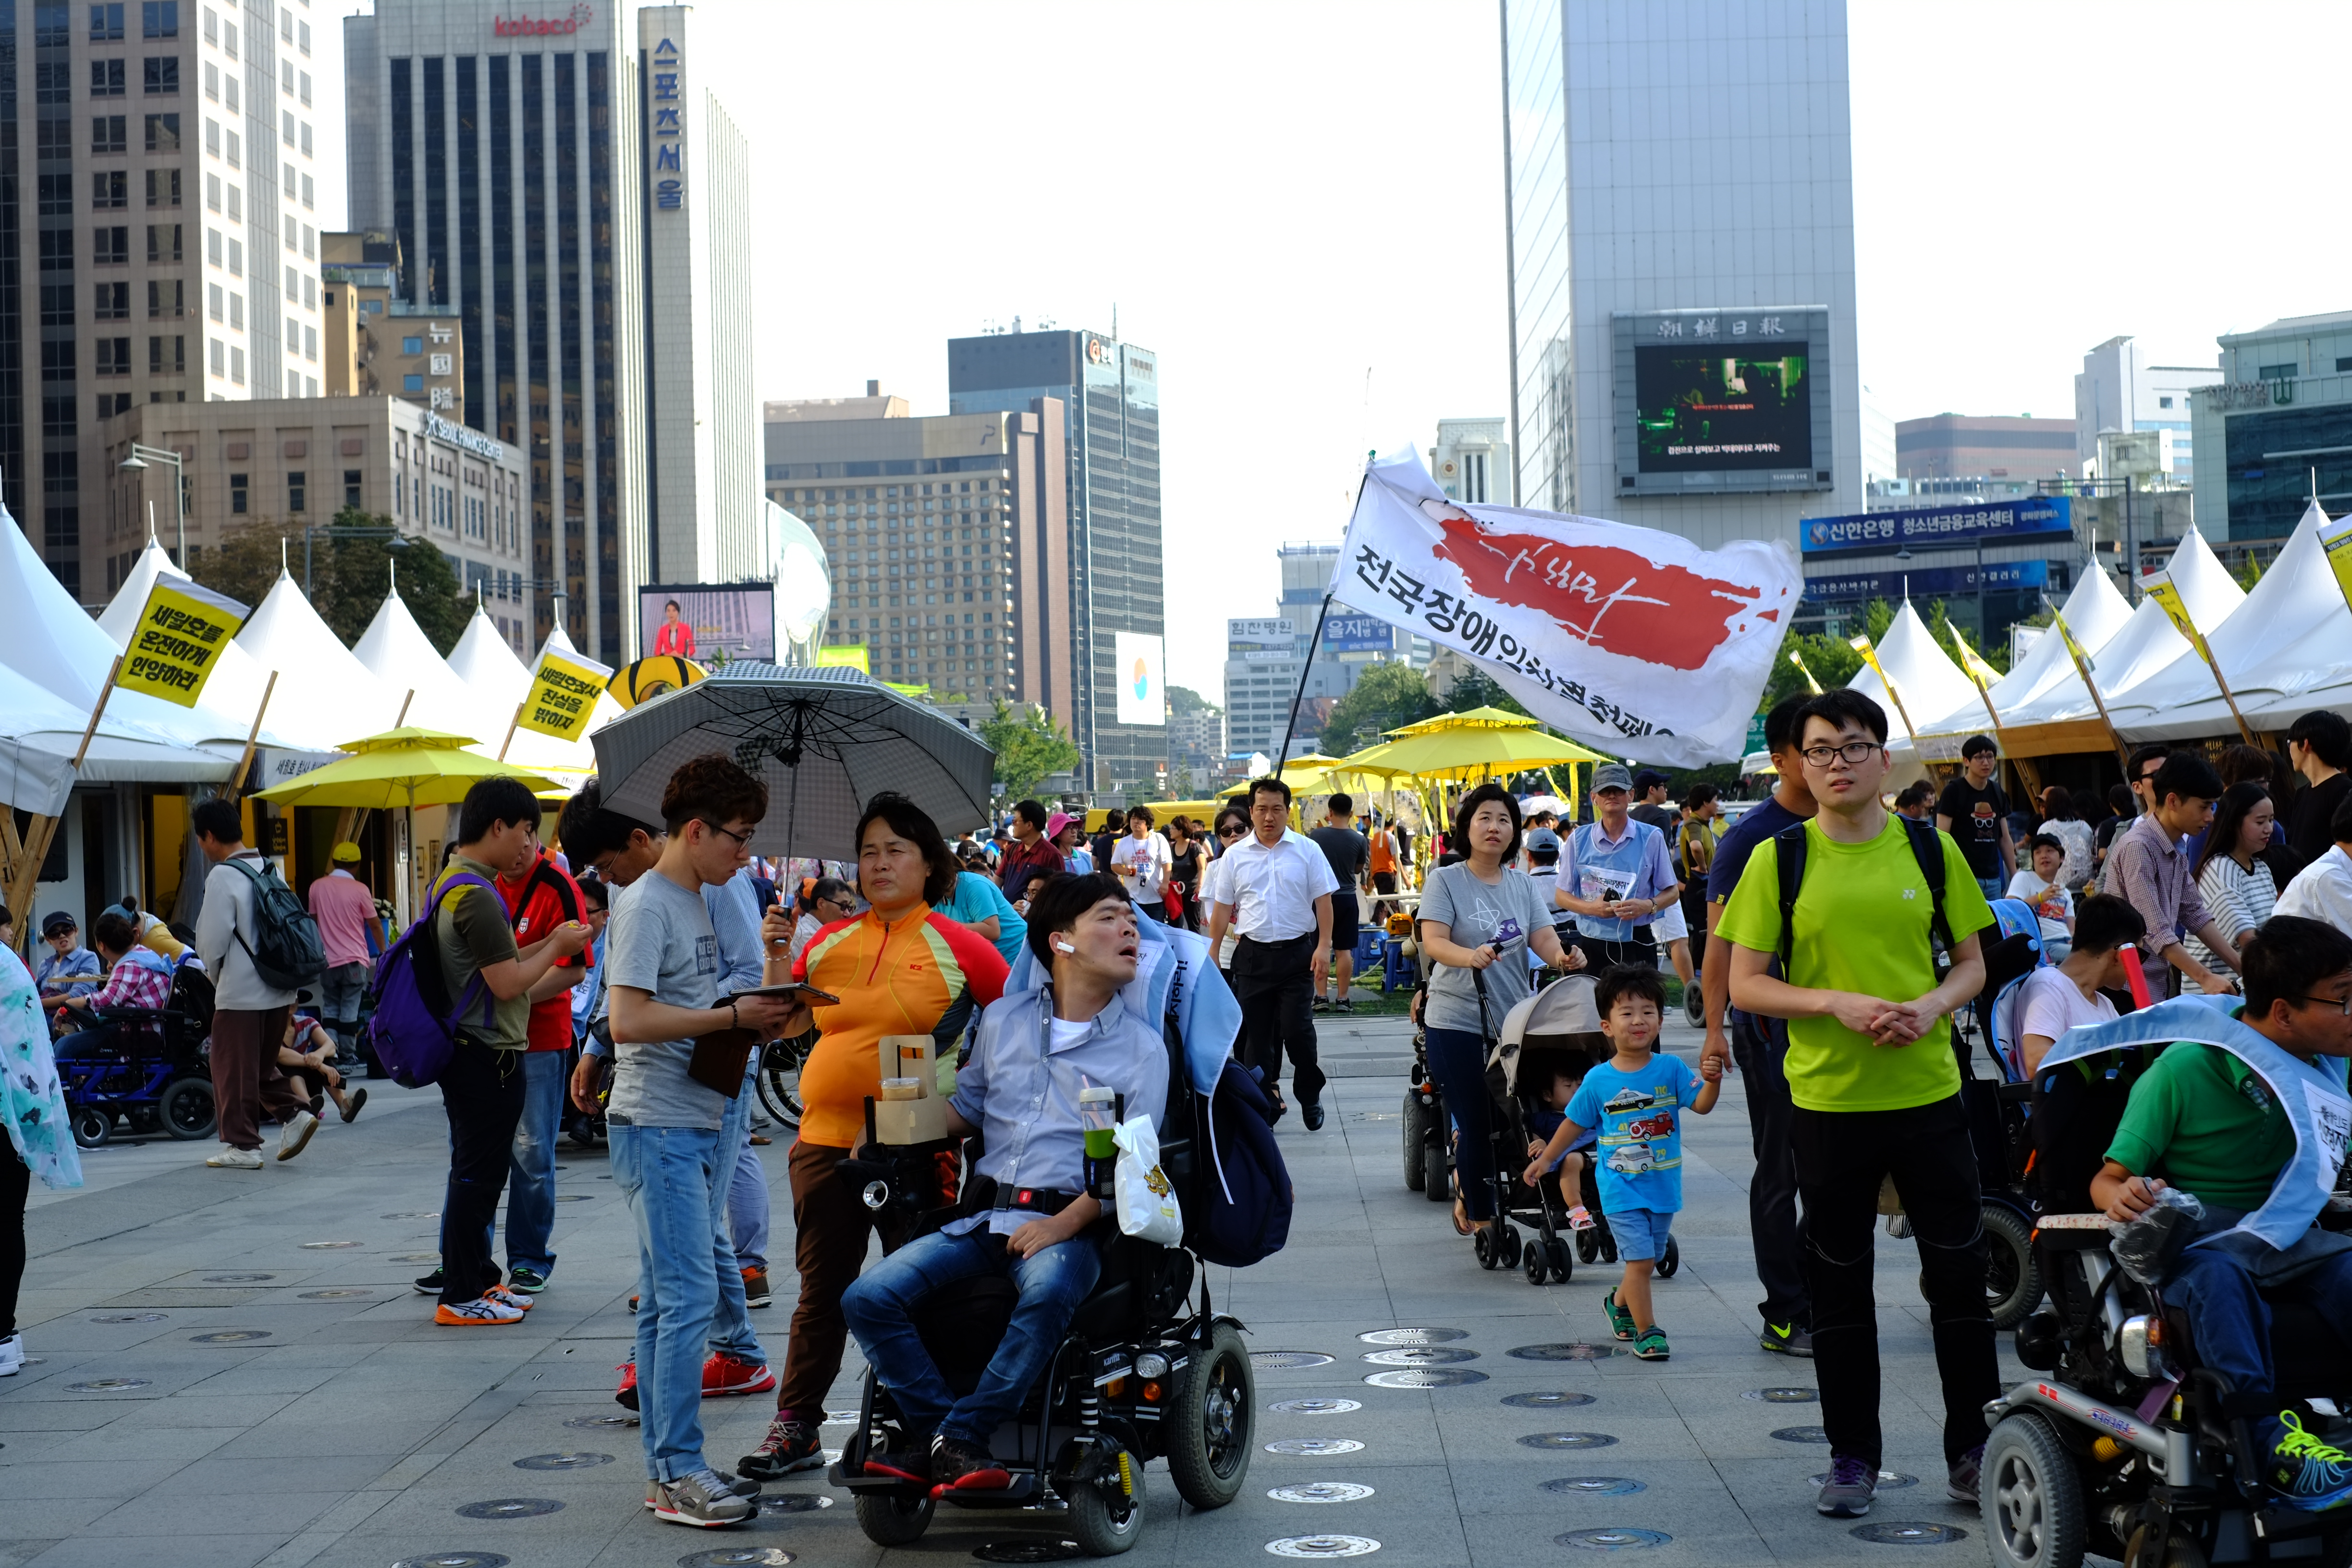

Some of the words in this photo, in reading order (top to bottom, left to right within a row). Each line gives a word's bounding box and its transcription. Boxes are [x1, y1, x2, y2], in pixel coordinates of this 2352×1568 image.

[495, 14, 576, 37] kobaco
[654, 37, 684, 209] 스포츠서울
[1657, 317, 1785, 338] 朝鮮日報
[1829, 519, 1894, 541] 신한은행
[1903, 509, 2013, 536] 청소년금융교육센터
[149, 605, 225, 644] 세월호를
[1232, 621, 1291, 635] 힘찬병원
[1327, 619, 1361, 638] 을지
[138, 630, 213, 667] 온전하게
[128, 656, 200, 692] 인양하라
[538, 667, 602, 699] 세월호참사
[540, 688, 583, 714] 진실을
[533, 707, 576, 730] 밝히자
[276, 759, 296, 775] 세월호
[1104, 1354, 1121, 1366] karma
[2092, 1411, 2130, 1434] SAHARA
